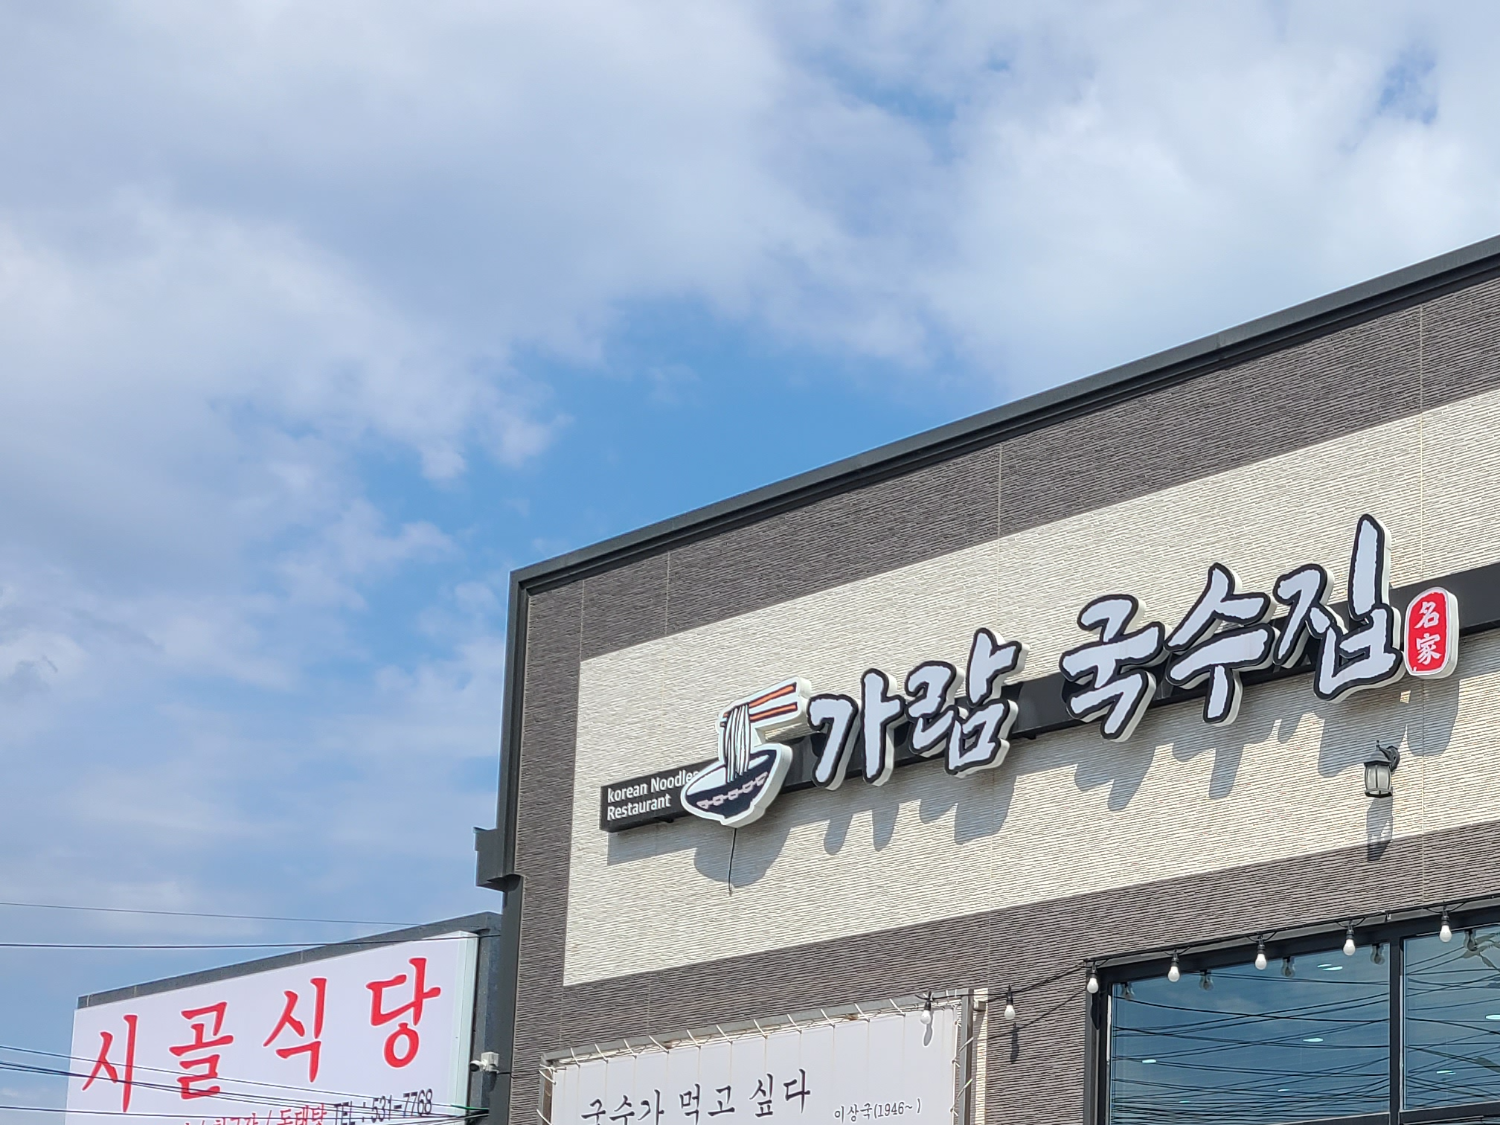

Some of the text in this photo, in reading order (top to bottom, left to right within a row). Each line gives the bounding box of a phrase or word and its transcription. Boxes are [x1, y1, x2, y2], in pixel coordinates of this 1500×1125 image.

[806, 513, 1406, 787] 가람 국수집
[1414, 601, 1442, 666] 名家
[607, 783, 648, 804] korean
[607, 793, 672, 821] Restaurant
[81, 957, 442, 1113] 시골식당
[371, 1087, 434, 1124] 531-7768
[679, 1084, 735, 1125] 먹고
[749, 1069, 810, 1117] 싶다
